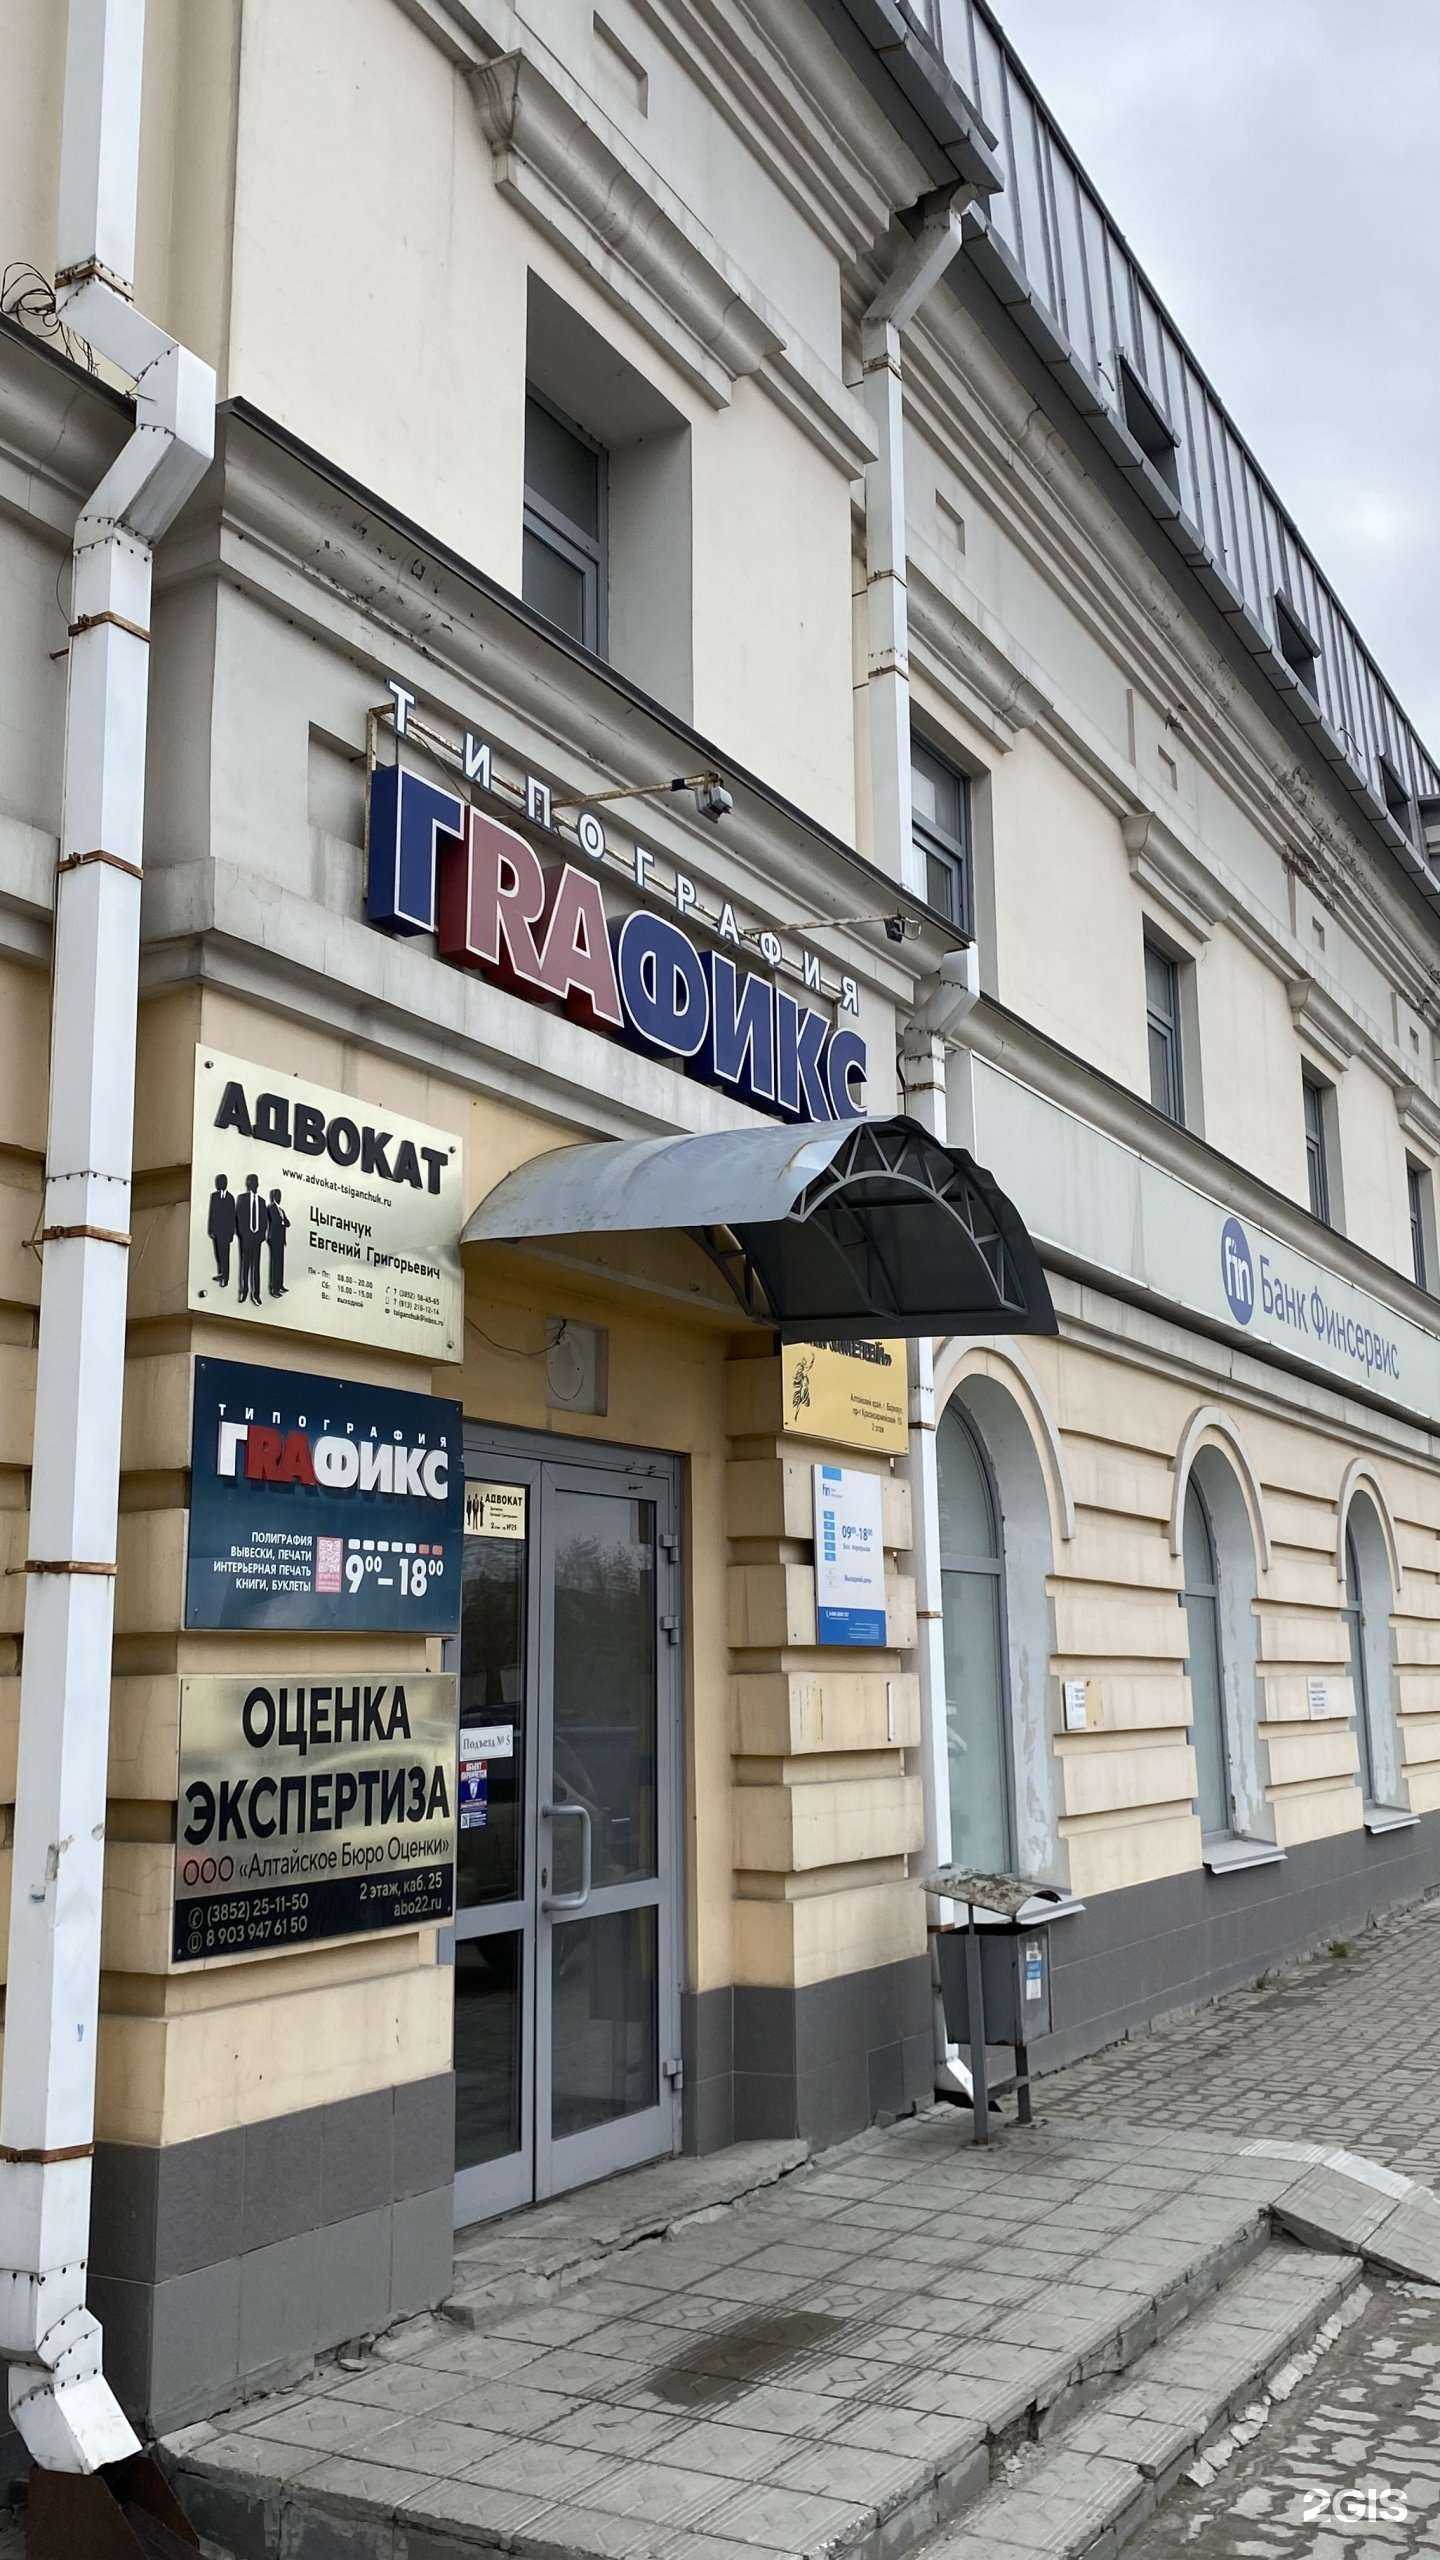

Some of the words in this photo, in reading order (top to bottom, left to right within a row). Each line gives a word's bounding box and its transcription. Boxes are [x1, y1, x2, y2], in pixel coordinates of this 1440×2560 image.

[386, 679, 860, 1018] ТИПОГРАФИЯ
[214, 1080, 449, 1195] АДВОКАТ
[282, 1168, 392, 1207] www.advokat-tsiganchuk.ru
[310, 1205, 372, 1239] Цыганчук
[309, 1231, 361, 1260] Евгений
[367, 1246, 440, 1280] Григорьевич
[1260, 1255, 1309, 1333] Банк
[1310, 1286, 1400, 1380] Финсервис
[218, 1403, 447, 1448] ТИПОГРАФИЯ
[485, 1493, 523, 1507] АДВОКАТ
[230, 1545, 275, 1560] ВЫВЕСКИ,
[278, 1549, 312, 1561] ПЕЧАТИ
[251, 1531, 313, 1547] ПОЛИГРАФИЯ
[213, 1560, 277, 1575] ИНТЕРЬЕРНАЯ
[279, 1564, 312, 1577] ПЕЧАТЬ
[235, 1578, 268, 1591] КНИГИ,
[271, 1580, 311, 1592] БУКЛЕТЫ
[242, 1685, 411, 1756] ОЦЕНКА
[184, 1765, 450, 1846] ЭКСПЕРТИЗА
[183, 1855, 234, 1886] ООО
[239, 1849, 337, 1880] «Алтайское
[342, 1842, 384, 1871] Бюро
[387, 1836, 449, 1862] Оценки»
[360, 1883, 367, 1900] 2
[370, 1878, 401, 1898] этаж,
[404, 1874, 426, 1893] каб.
[429, 1872, 442, 1889] 25
[207, 1901, 250, 1925] (3852)
[253, 1892, 309, 1917] 25-11-50
[394, 1896, 442, 1917] abo22.ru
[206, 1930, 215, 1947] 8
[216, 1925, 245, 1944] 903
[249, 1921, 273, 1940] 947
[273, 1919, 288, 1936] 61
[290, 1916, 308, 1933] 50
